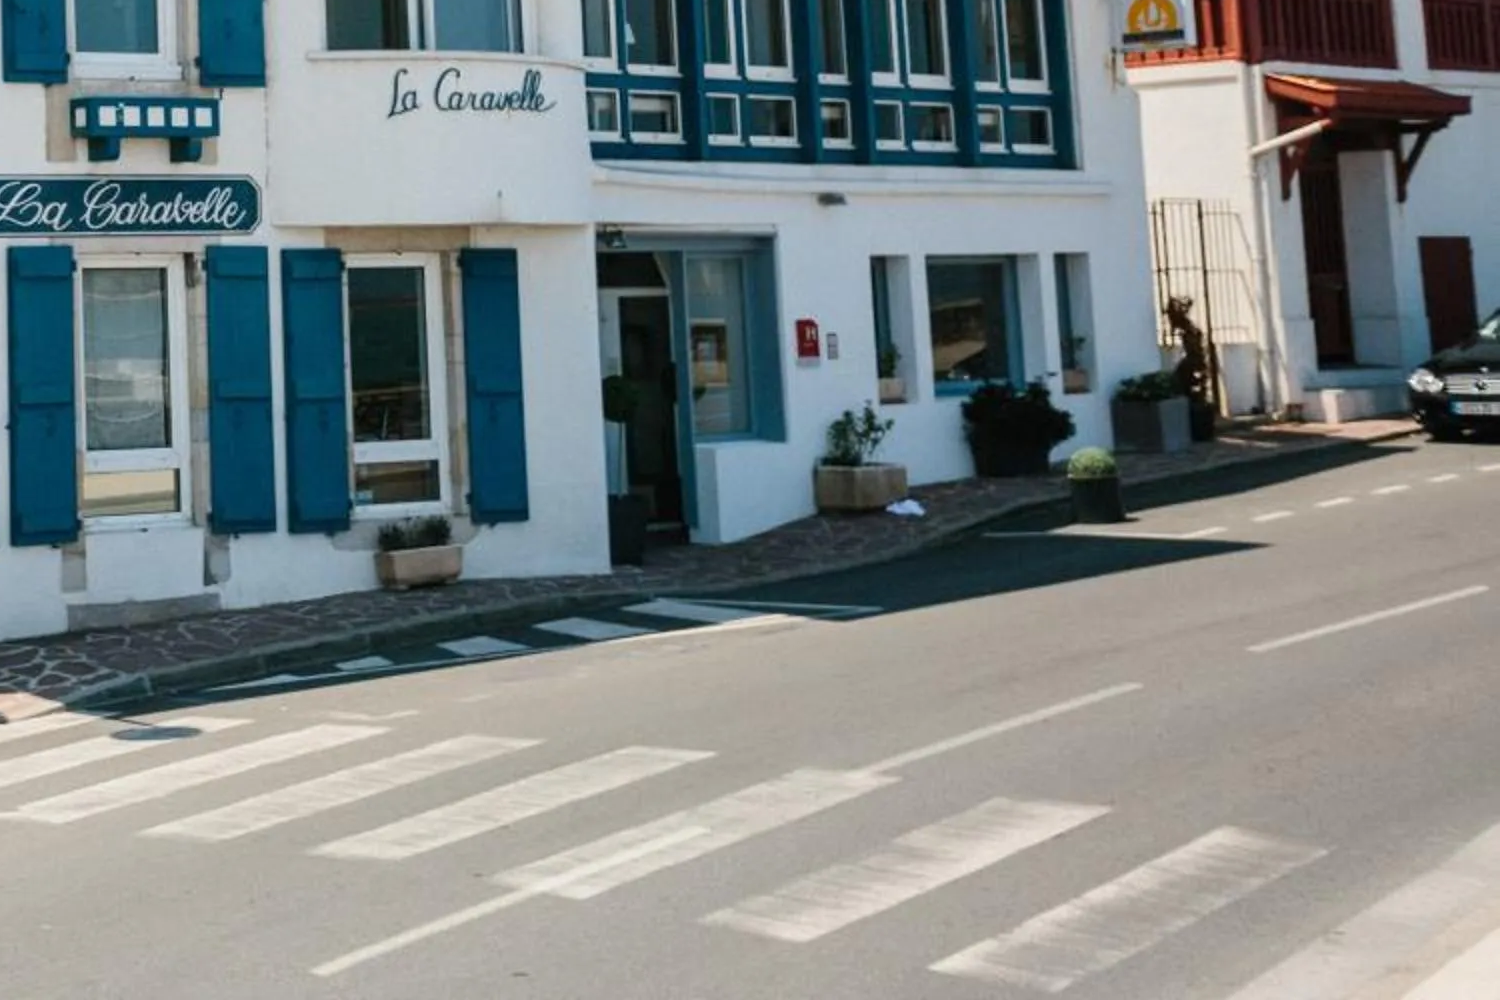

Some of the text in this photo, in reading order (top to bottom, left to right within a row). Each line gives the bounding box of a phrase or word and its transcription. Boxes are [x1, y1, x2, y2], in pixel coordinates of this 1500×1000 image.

[387, 67, 557, 119] La Caravelle
[79, 180, 246, 229] Caravelle
